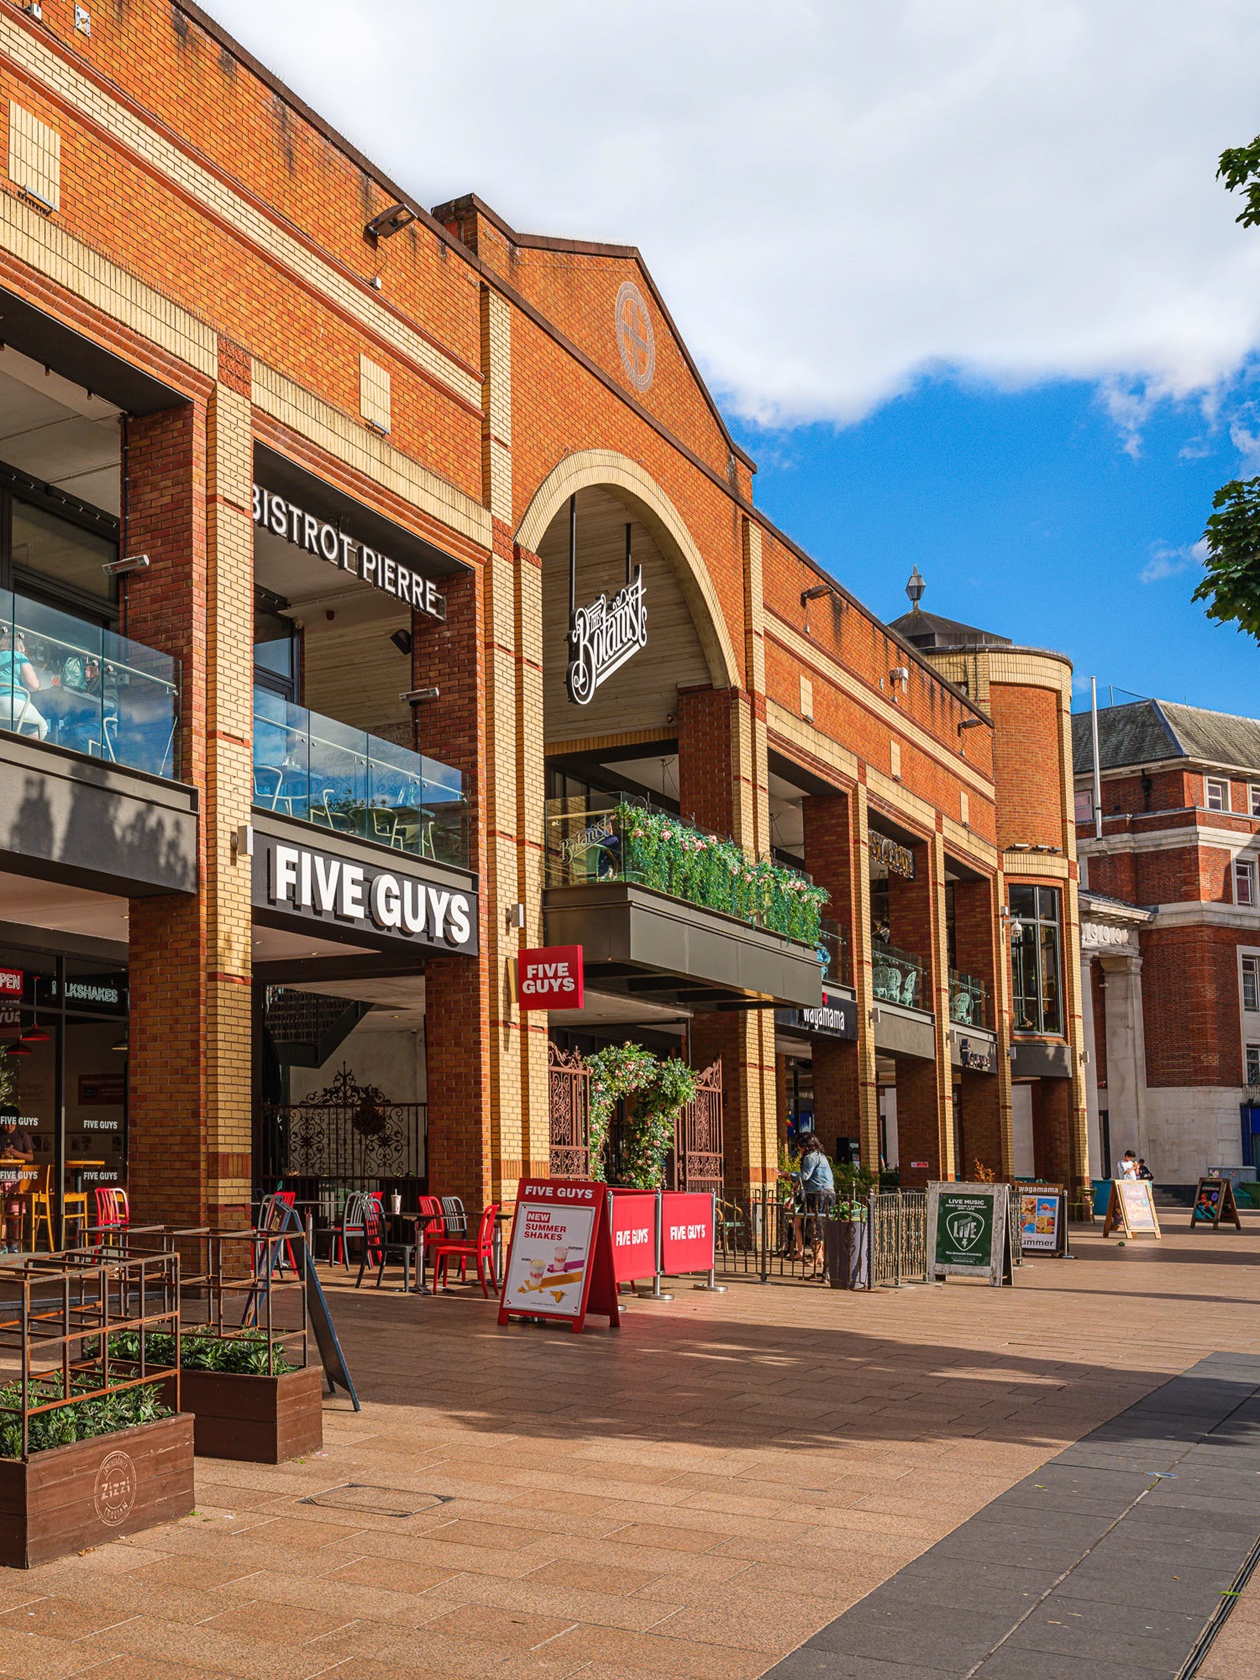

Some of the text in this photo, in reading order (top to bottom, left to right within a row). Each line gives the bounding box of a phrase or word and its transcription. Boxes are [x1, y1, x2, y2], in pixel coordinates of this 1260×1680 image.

[253, 483, 437, 615] BISTROT PIERRE
[276, 845, 471, 944] FIVE GUYS
[526, 962, 569, 978] FIVE
[52, 980, 118, 1003] LKSHAKES
[522, 977, 575, 995] GUYS
[803, 1007, 844, 1030] wagamama
[0, 1116, 38, 1126] FIVE GUYS
[83, 1120, 118, 1129] FIVE GUYS
[0, 1171, 38, 1179] FIVE GUYS
[83, 1172, 118, 1180] FIVE GUYS
[525, 1185, 593, 1199] FIVE GUYS
[1019, 1186, 1058, 1194] wagamama
[527, 1213, 549, 1221] NEW
[525, 1223, 567, 1233] SUMMER
[670, 1224, 706, 1240] FIVE GUYS
[524, 1231, 563, 1241] SHAKES
[616, 1228, 649, 1246] FIVE GUYS
